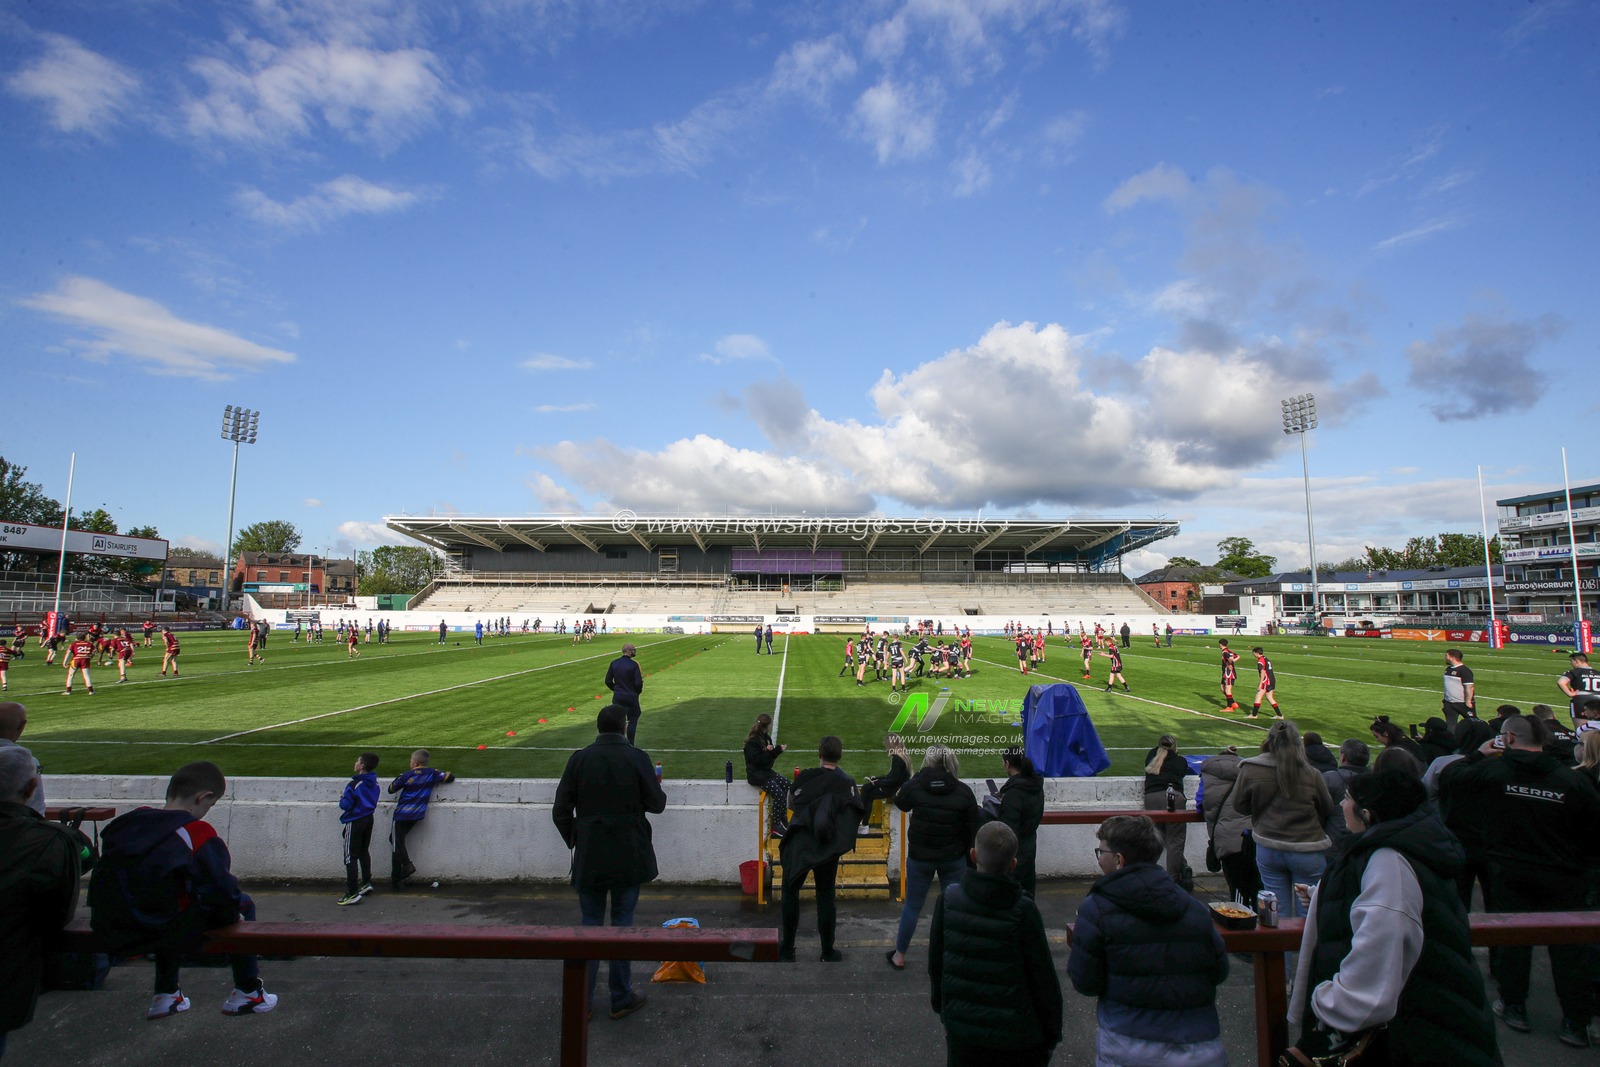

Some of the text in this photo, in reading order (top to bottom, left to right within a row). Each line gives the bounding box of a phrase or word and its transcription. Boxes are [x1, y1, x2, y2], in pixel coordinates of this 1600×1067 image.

[3, 525, 27, 536] 8487
[1505, 581, 1574, 590] BISTRO HORBURY
[1520, 633, 1547, 641] NORTHERN
[1582, 677, 1600, 691] 10
[1506, 784, 1564, 799] KERRY
